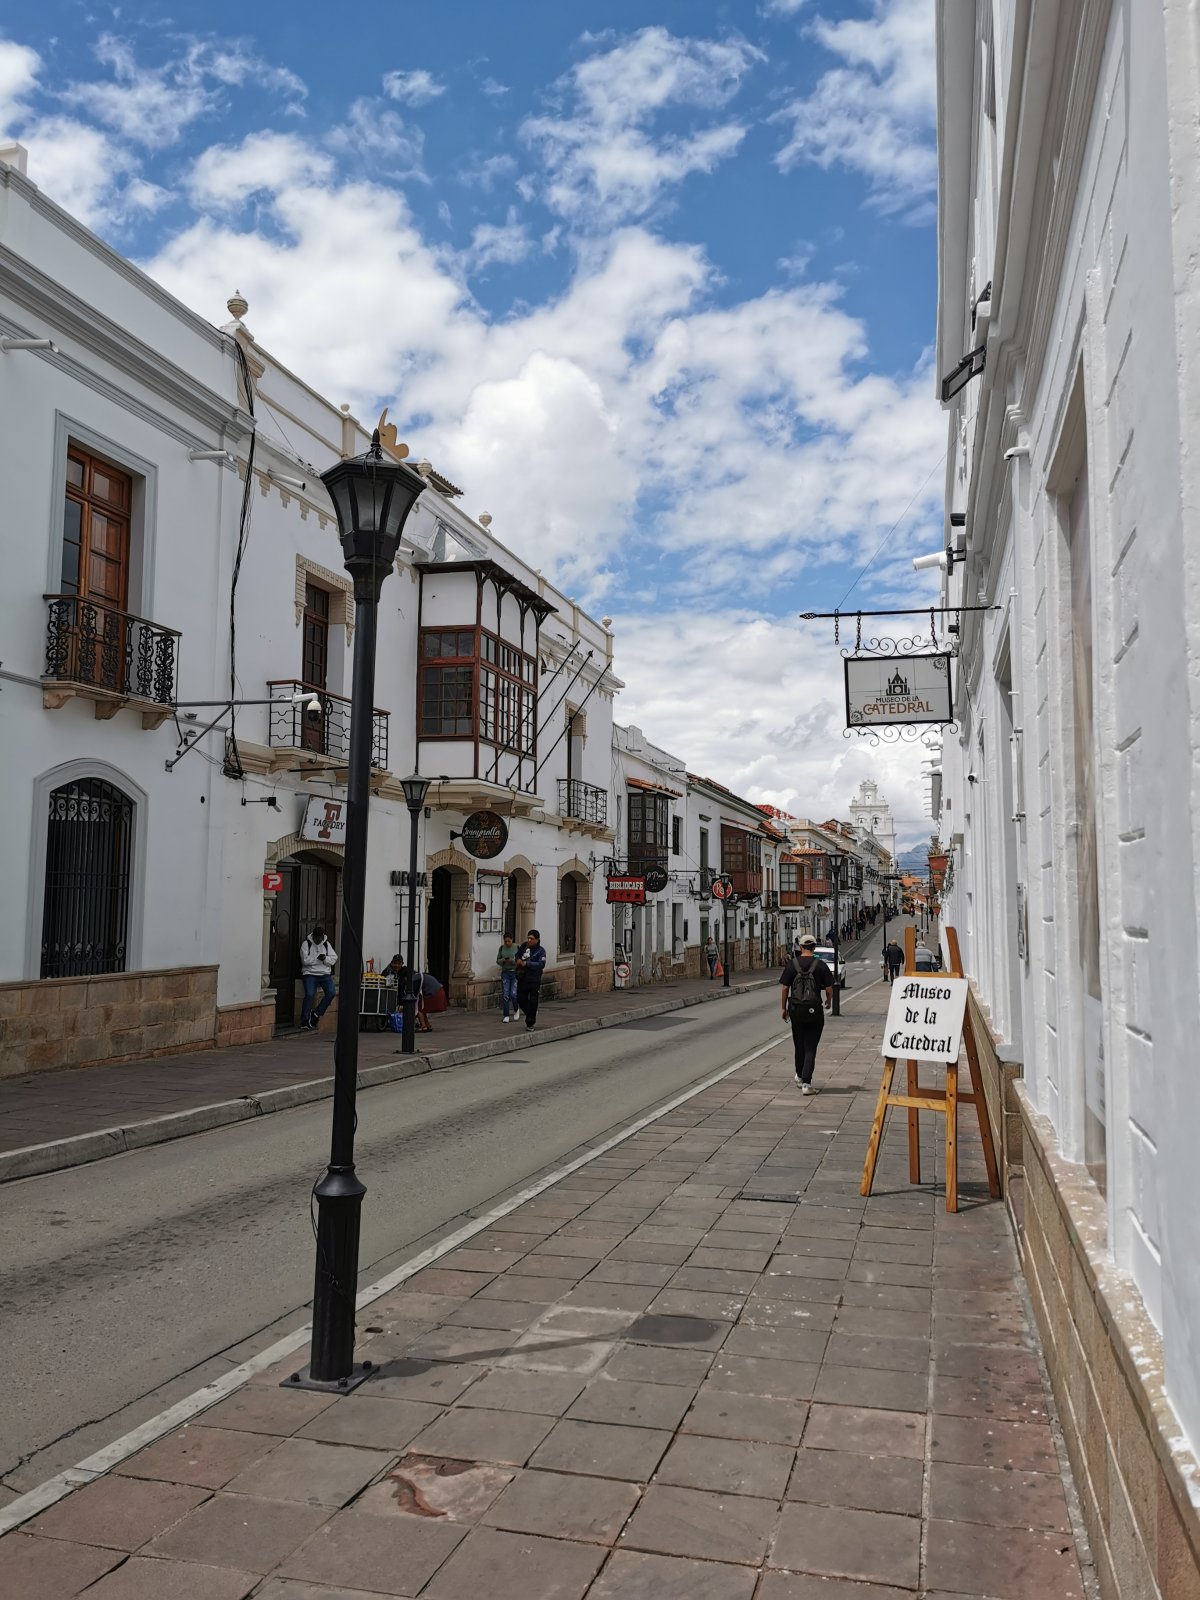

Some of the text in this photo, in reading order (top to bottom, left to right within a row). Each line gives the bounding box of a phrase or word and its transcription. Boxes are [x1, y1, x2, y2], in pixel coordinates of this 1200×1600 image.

[862, 701, 934, 716] CATEDRAL
[313, 818, 346, 830] FACTORY
[609, 881, 644, 891] BIBLIOCAFE
[900, 983, 951, 1000] Museo
[905, 1007, 937, 1024] de la
[889, 1032, 952, 1053] Catedral
